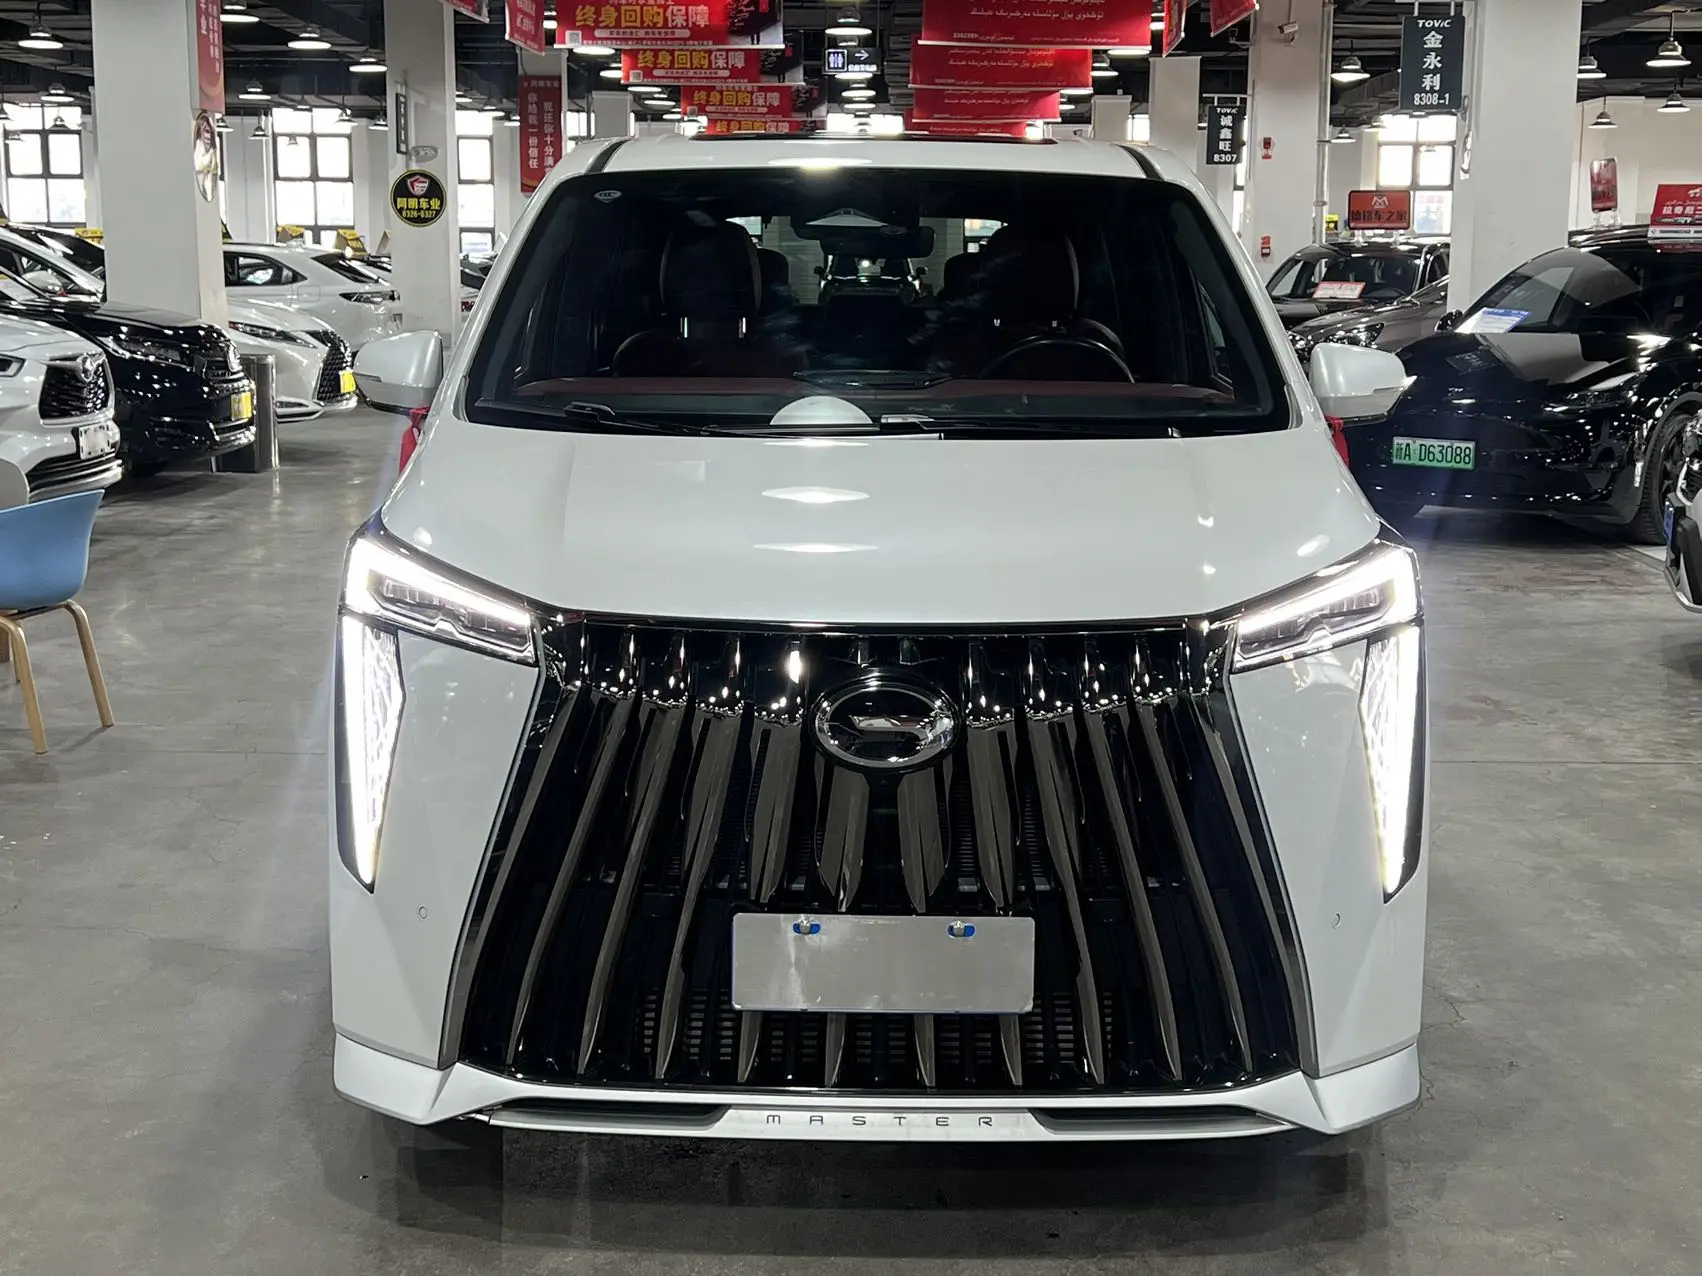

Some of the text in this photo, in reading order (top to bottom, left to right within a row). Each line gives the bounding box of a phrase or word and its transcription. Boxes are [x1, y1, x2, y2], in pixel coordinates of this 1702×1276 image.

[575, 5, 710, 28] 终身回购保障
[637, 50, 745, 70] 终身回购保障
[1421, 30, 1443, 91] 金永利
[693, 90, 781, 107] 终身回购保障
[1413, 92, 1450, 106] 8308-1
[527, 93, 539, 169] 你给我一份信任
[1218, 115, 1233, 152] 诚鑫旺
[1213, 153, 1237, 162] 8307
[396, 197, 441, 210] 阿明车业
[401, 210, 436, 218] 8326-8327
[766, 1114, 993, 1127] MASTER
